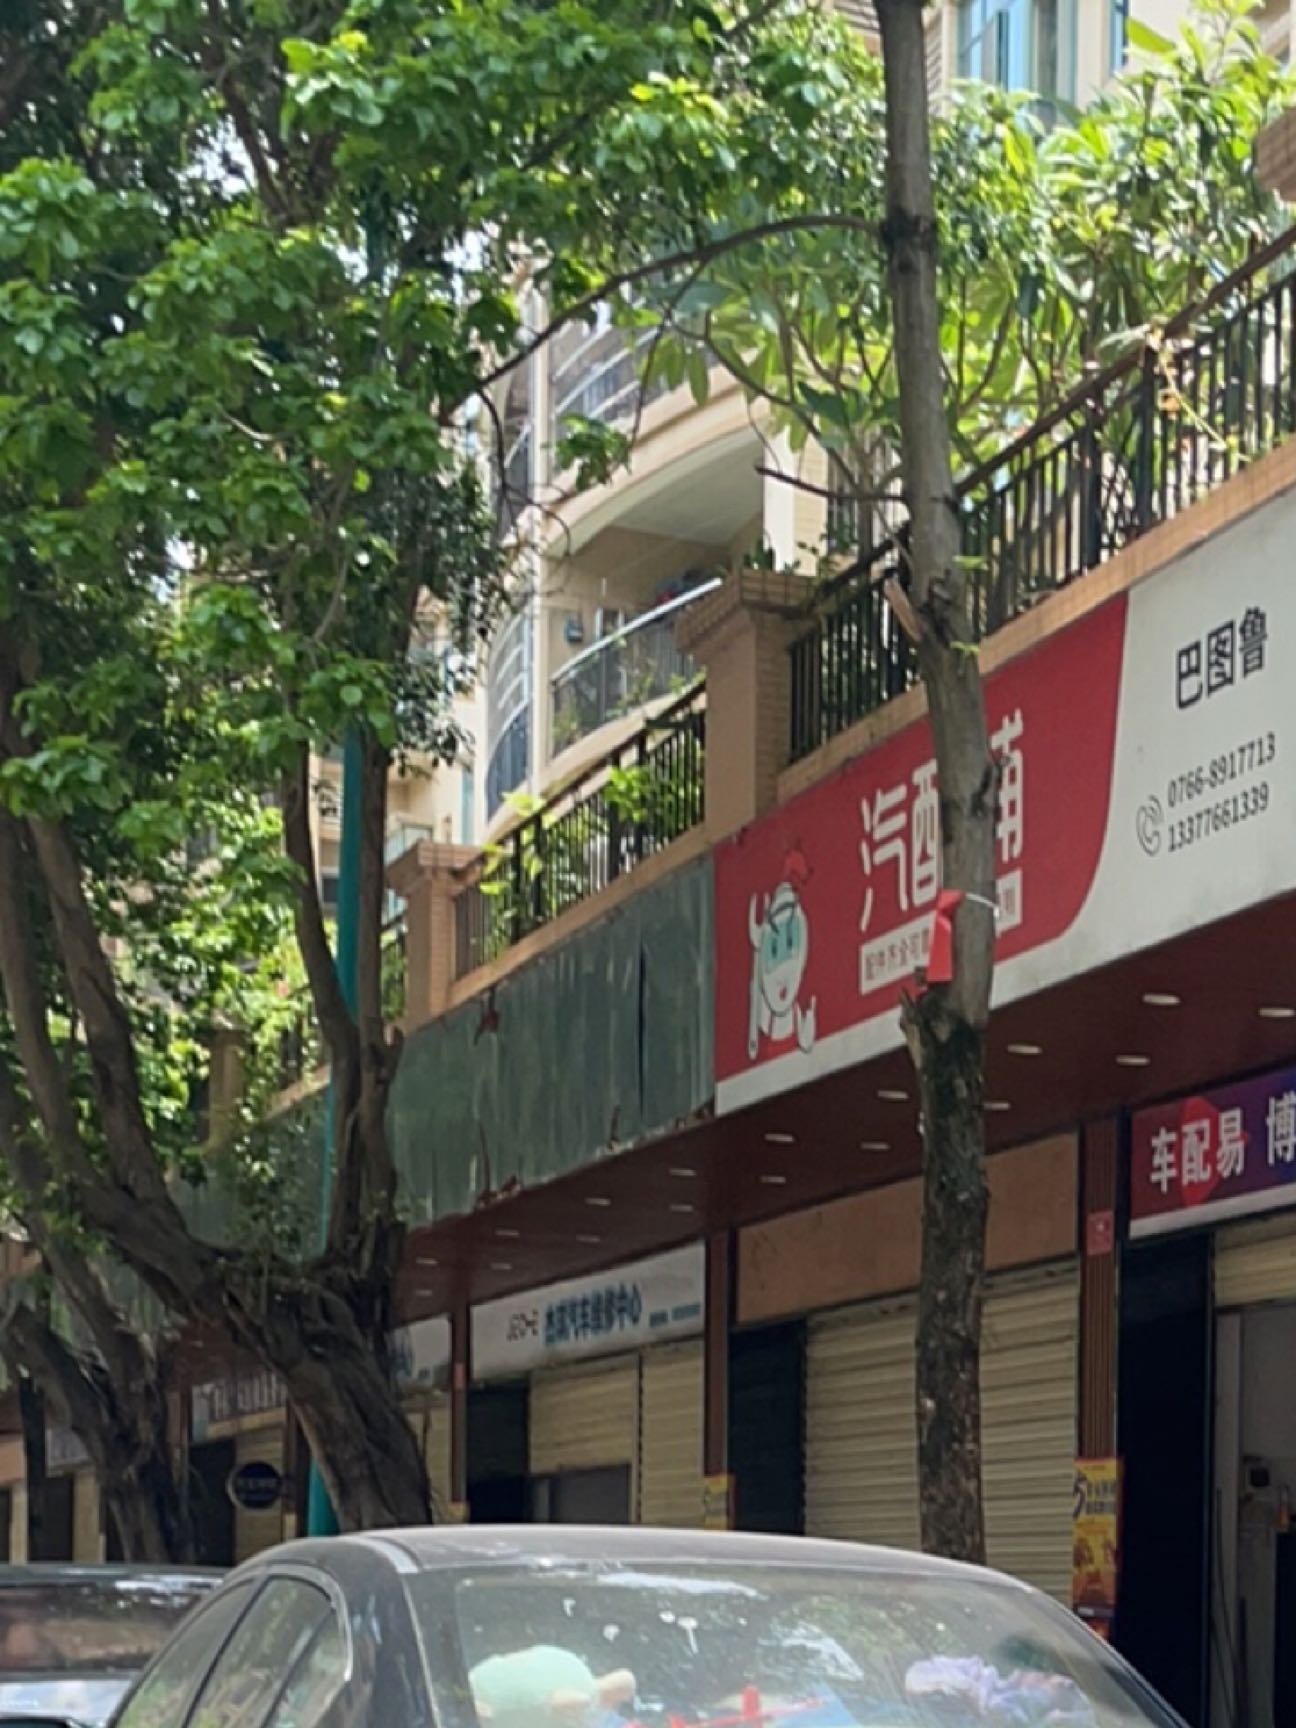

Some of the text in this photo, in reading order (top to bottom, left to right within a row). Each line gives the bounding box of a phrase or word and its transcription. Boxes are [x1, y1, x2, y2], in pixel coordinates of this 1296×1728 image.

[1175, 605, 1268, 710] 巴图鲁
[1150, 1109, 1247, 1193] 车配易
